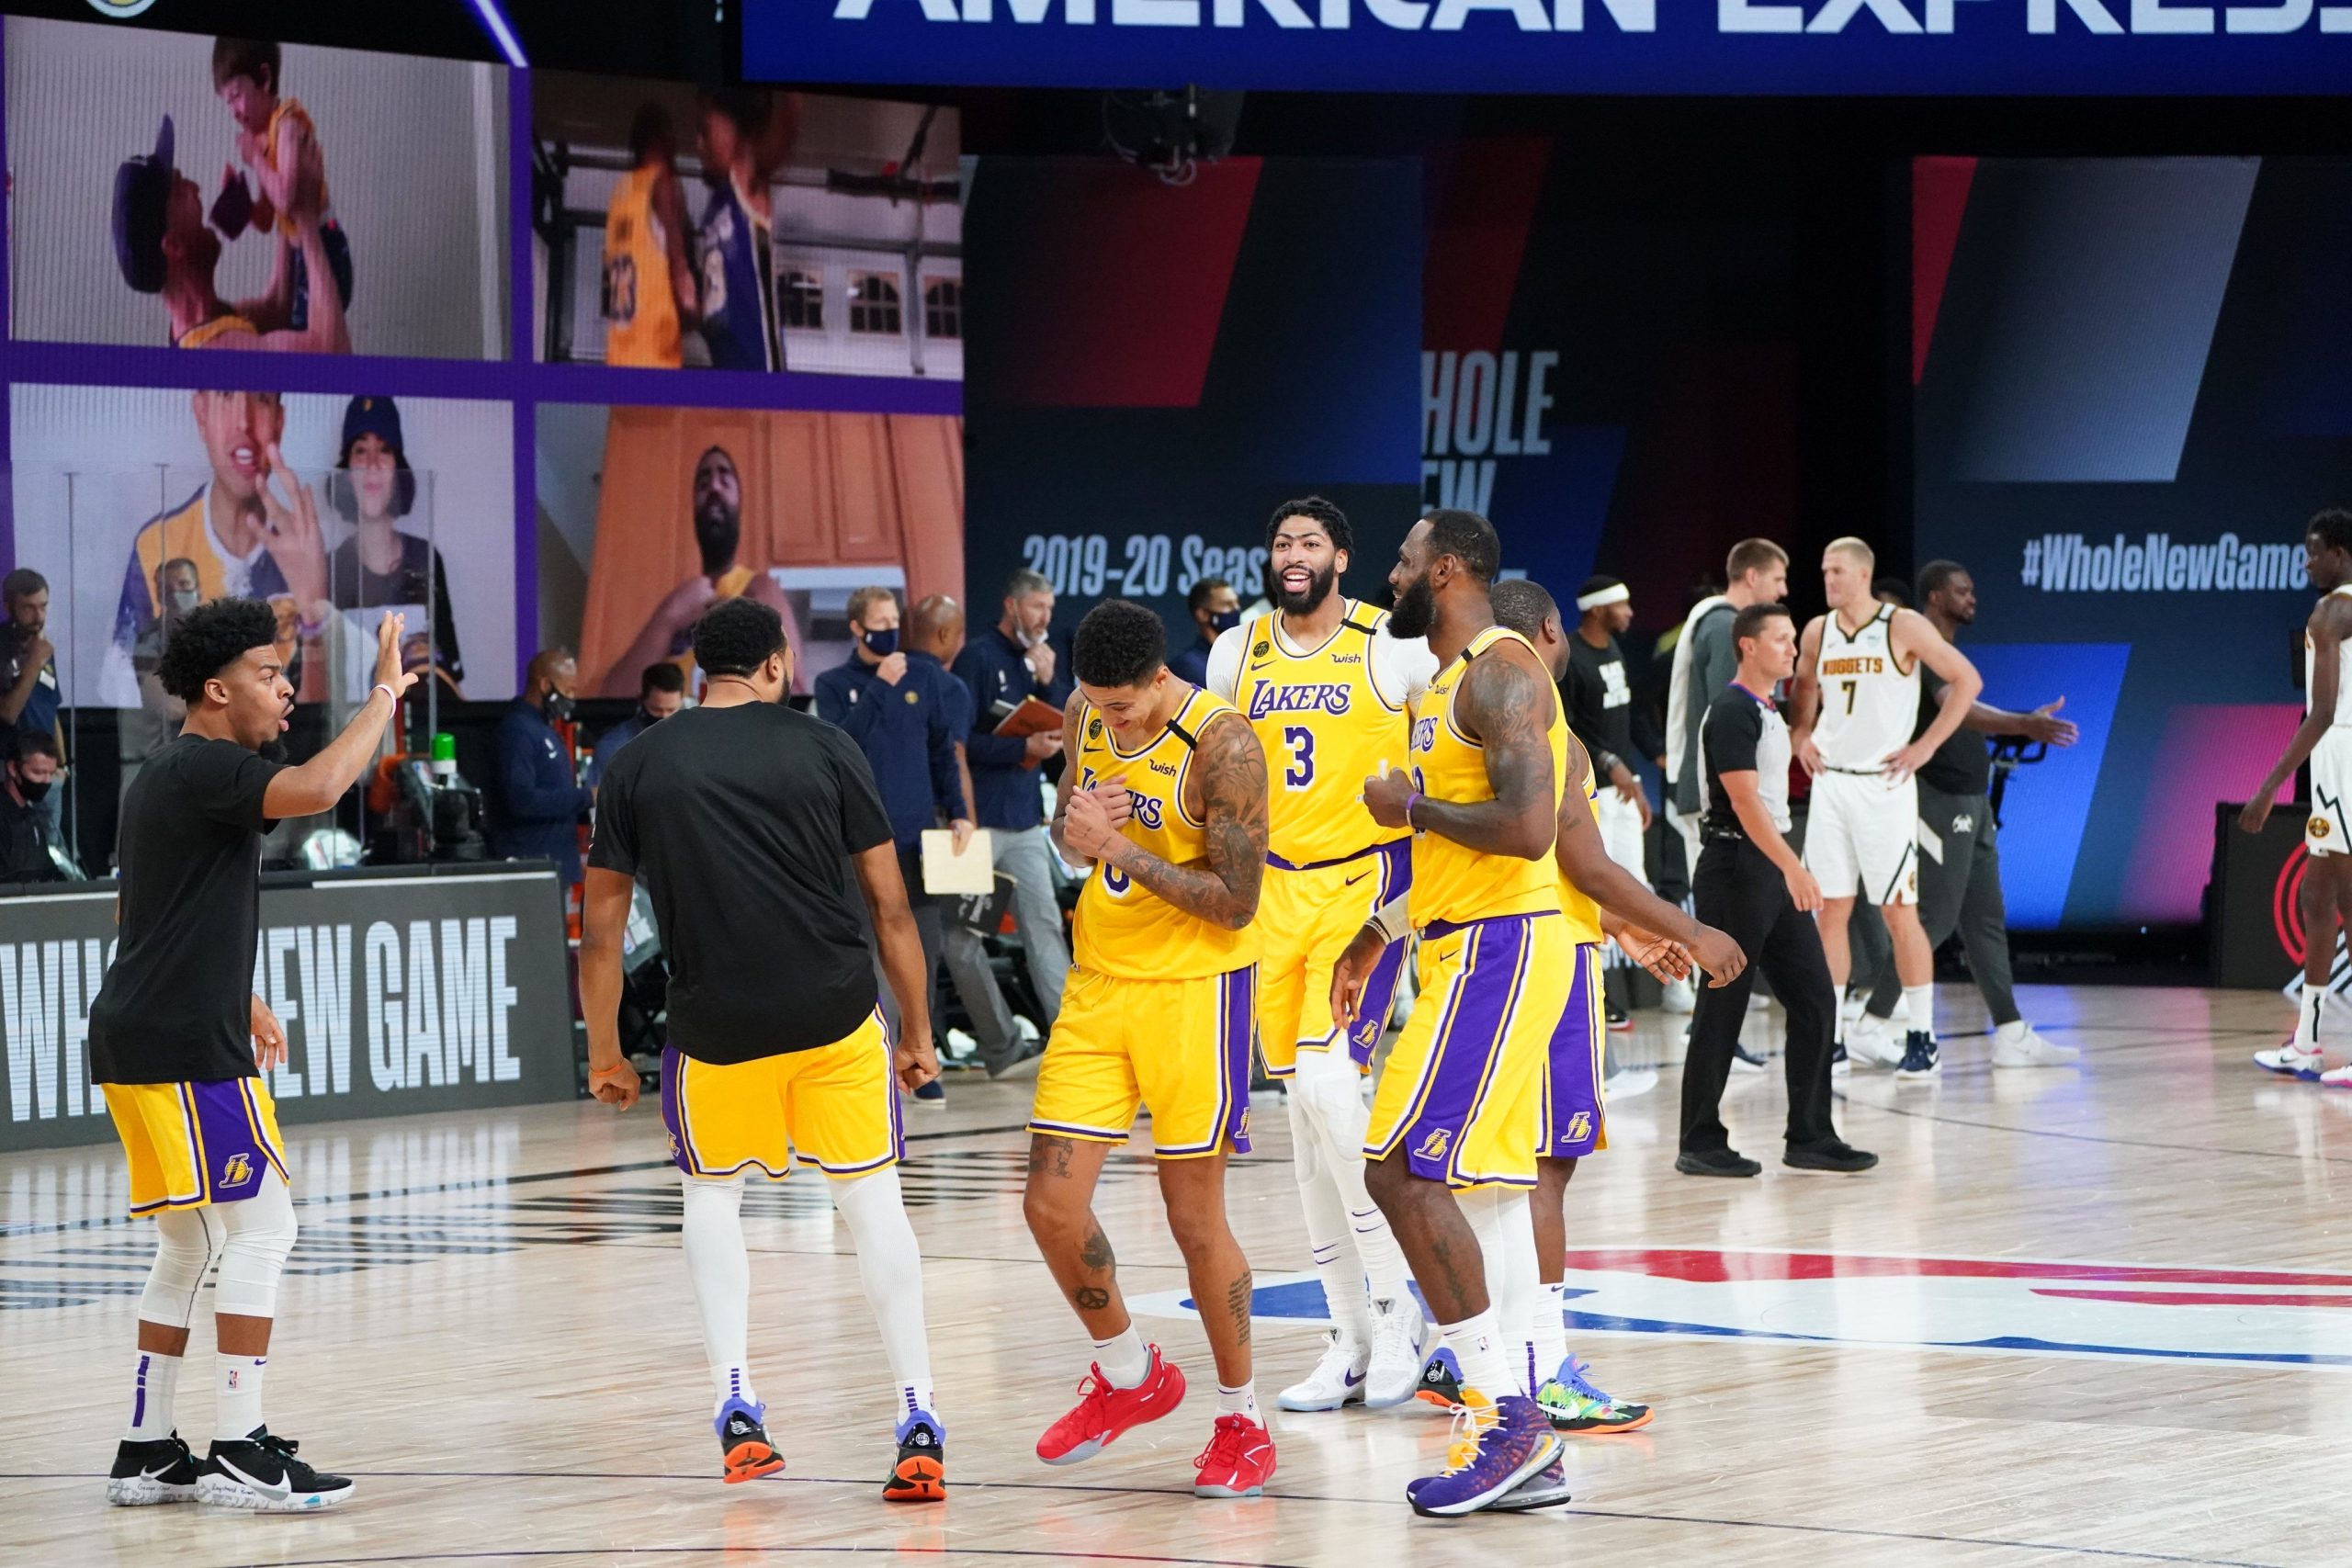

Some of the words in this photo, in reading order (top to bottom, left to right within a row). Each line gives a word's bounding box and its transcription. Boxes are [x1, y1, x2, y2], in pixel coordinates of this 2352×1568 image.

[1421, 351, 1559, 456] HOLE
[1177, 535, 1270, 596] Seas
[2021, 533, 2310, 592] #WholeNewGame
[1331, 653, 1362, 664] wish
[1248, 679, 1352, 721] LAKERS
[1841, 680, 1858, 716] 7
[1149, 759, 1177, 778] wish
[1284, 725, 1316, 793] 3
[365, 916, 521, 1093] GAME
